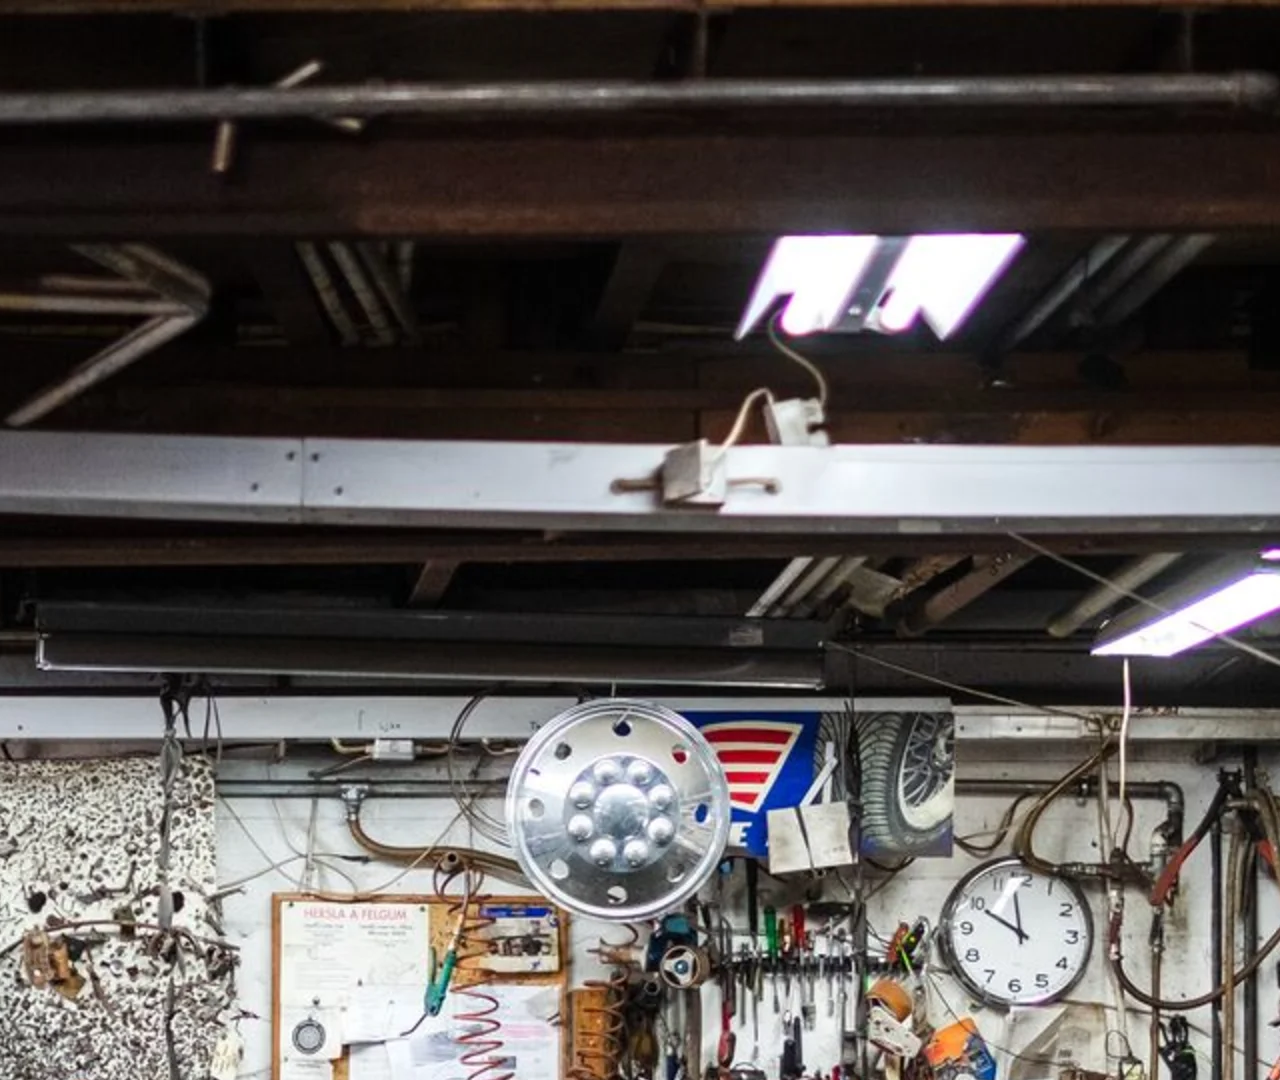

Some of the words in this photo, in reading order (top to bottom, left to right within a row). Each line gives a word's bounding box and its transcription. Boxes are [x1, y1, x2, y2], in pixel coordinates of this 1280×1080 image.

[993, 877, 1003, 891] 11
[1047, 879, 1053, 896] 1
[970, 897, 985, 911] 10
[1059, 903, 1073, 917] 2
[960, 921, 974, 935] 9
[1064, 930, 1079, 945] 3
[965, 948, 980, 962] 8
[1055, 957, 1068, 970] 4
[984, 969, 996, 983] 7
[1035, 974, 1049, 988] 5
[1008, 979, 1022, 993] 6
